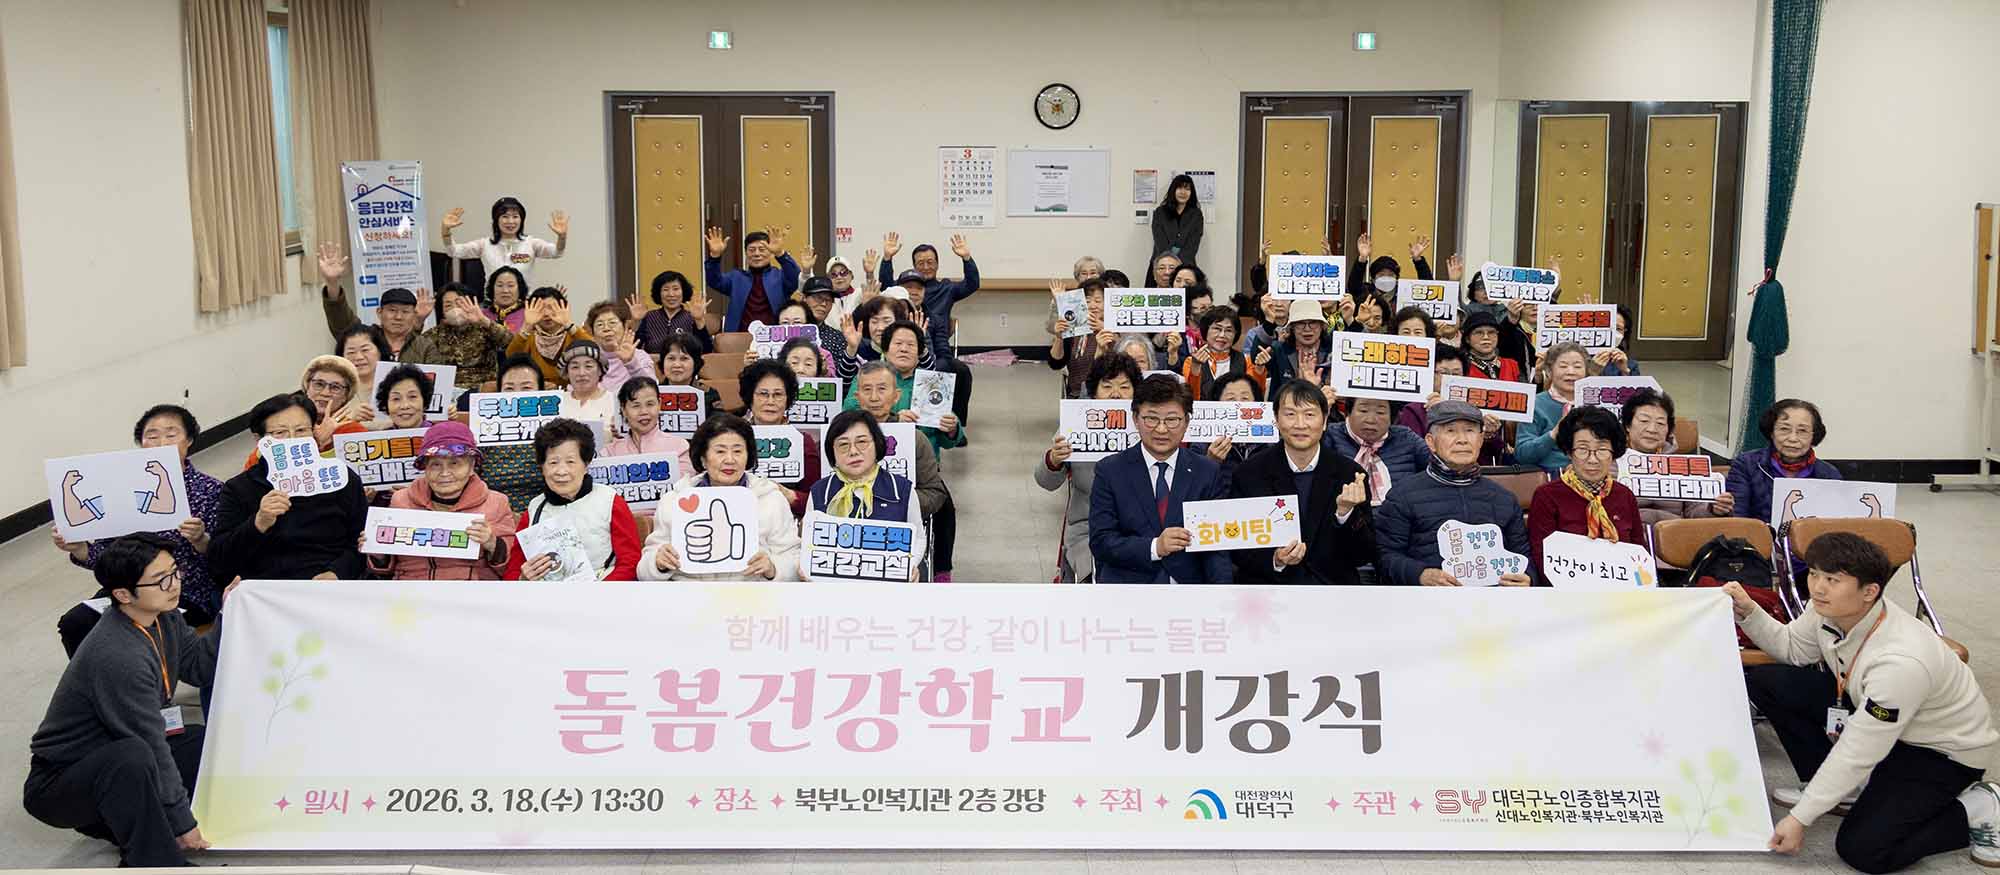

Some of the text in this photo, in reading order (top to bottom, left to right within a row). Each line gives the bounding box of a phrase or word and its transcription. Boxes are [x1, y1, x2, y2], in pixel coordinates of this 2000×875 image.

[964, 149, 972, 159] 3
[358, 200, 414, 215] 응급안전
[1341, 339, 1430, 367] 노래하는
[1347, 365, 1420, 393] 비타민
[1448, 385, 1527, 414] 힐링카페
[479, 420, 547, 443] 보드게
[1085, 408, 1128, 430] 함께
[271, 443, 289, 471] 몸
[278, 468, 315, 494] 마음
[375, 525, 470, 549] 대덕구최고
[812, 520, 913, 552] 라이프핏
[1448, 528, 1497, 555] 몸 건강
[810, 549, 911, 581] 건강교실
[1453, 554, 1521, 579] 마음 건강
[1546, 555, 1629, 581] 건강이 최고
[724, 615, 789, 653] 함께
[799, 615, 898, 653] 배우는
[984, 615, 1049, 653] 같이
[1059, 615, 1160, 653] 나누는
[1165, 617, 1231, 654] 돌봄
[553, 667, 1382, 754] 돌봄건강학교 개강식
[304, 789, 349, 814] 일시
[386, 788, 463, 813] 2026.
[470, 788, 494, 813] 3.
[590, 788, 664, 812] 13:30
[714, 787, 1047, 812] 장소 북부노인복지관 2층 강당
[1099, 788, 1143, 812] 주최
[1235, 790, 1293, 801] 대전광역시
[1353, 790, 1397, 815] 주관
[1492, 789, 1661, 809] 대덕구노인종합복지관
[1235, 802, 1294, 819] 대덕구
